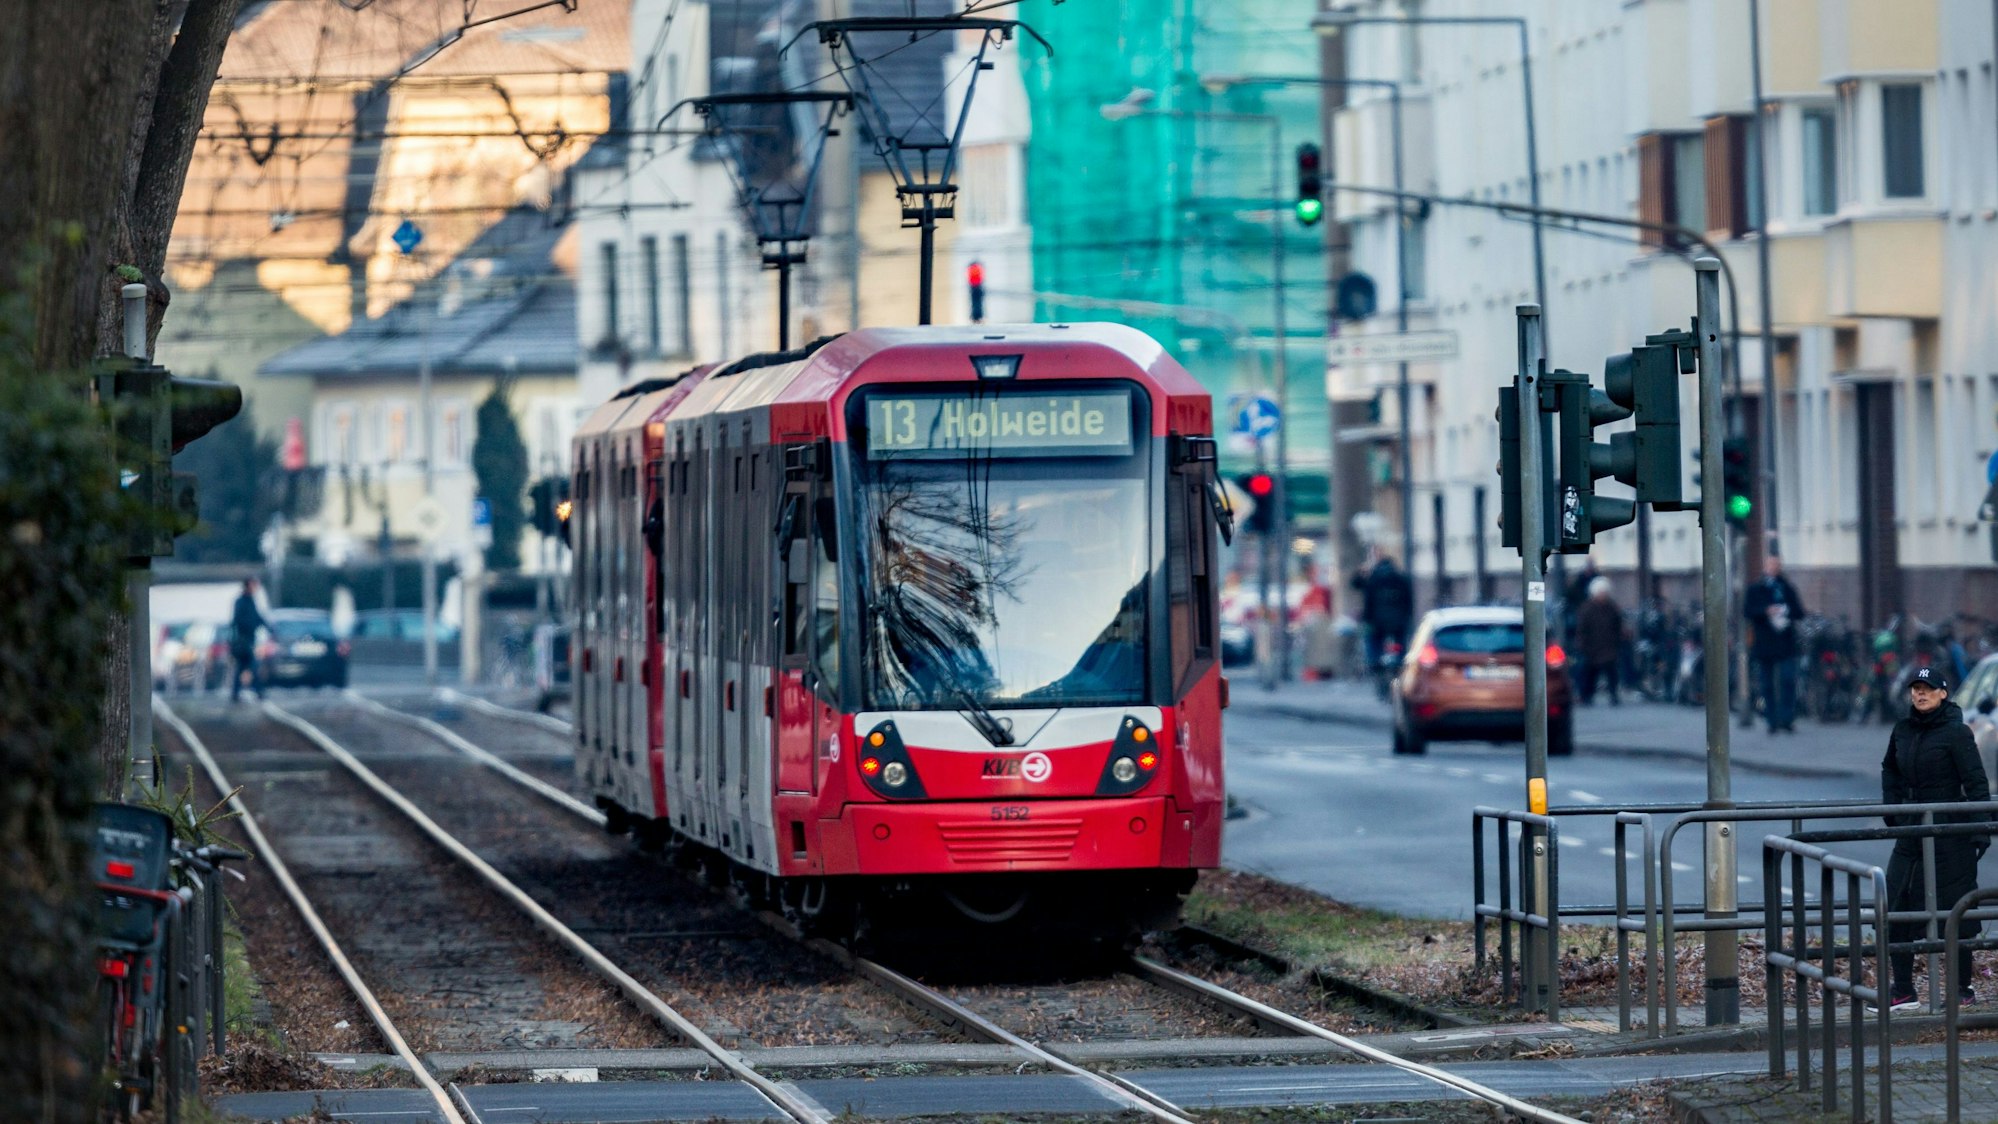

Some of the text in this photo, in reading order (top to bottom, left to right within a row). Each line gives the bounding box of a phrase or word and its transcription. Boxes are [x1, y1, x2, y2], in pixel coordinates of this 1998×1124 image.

[881, 399, 1105, 445] 13 Holweide
[982, 758, 1021, 775] KVB
[991, 806, 1030, 820] 5152
